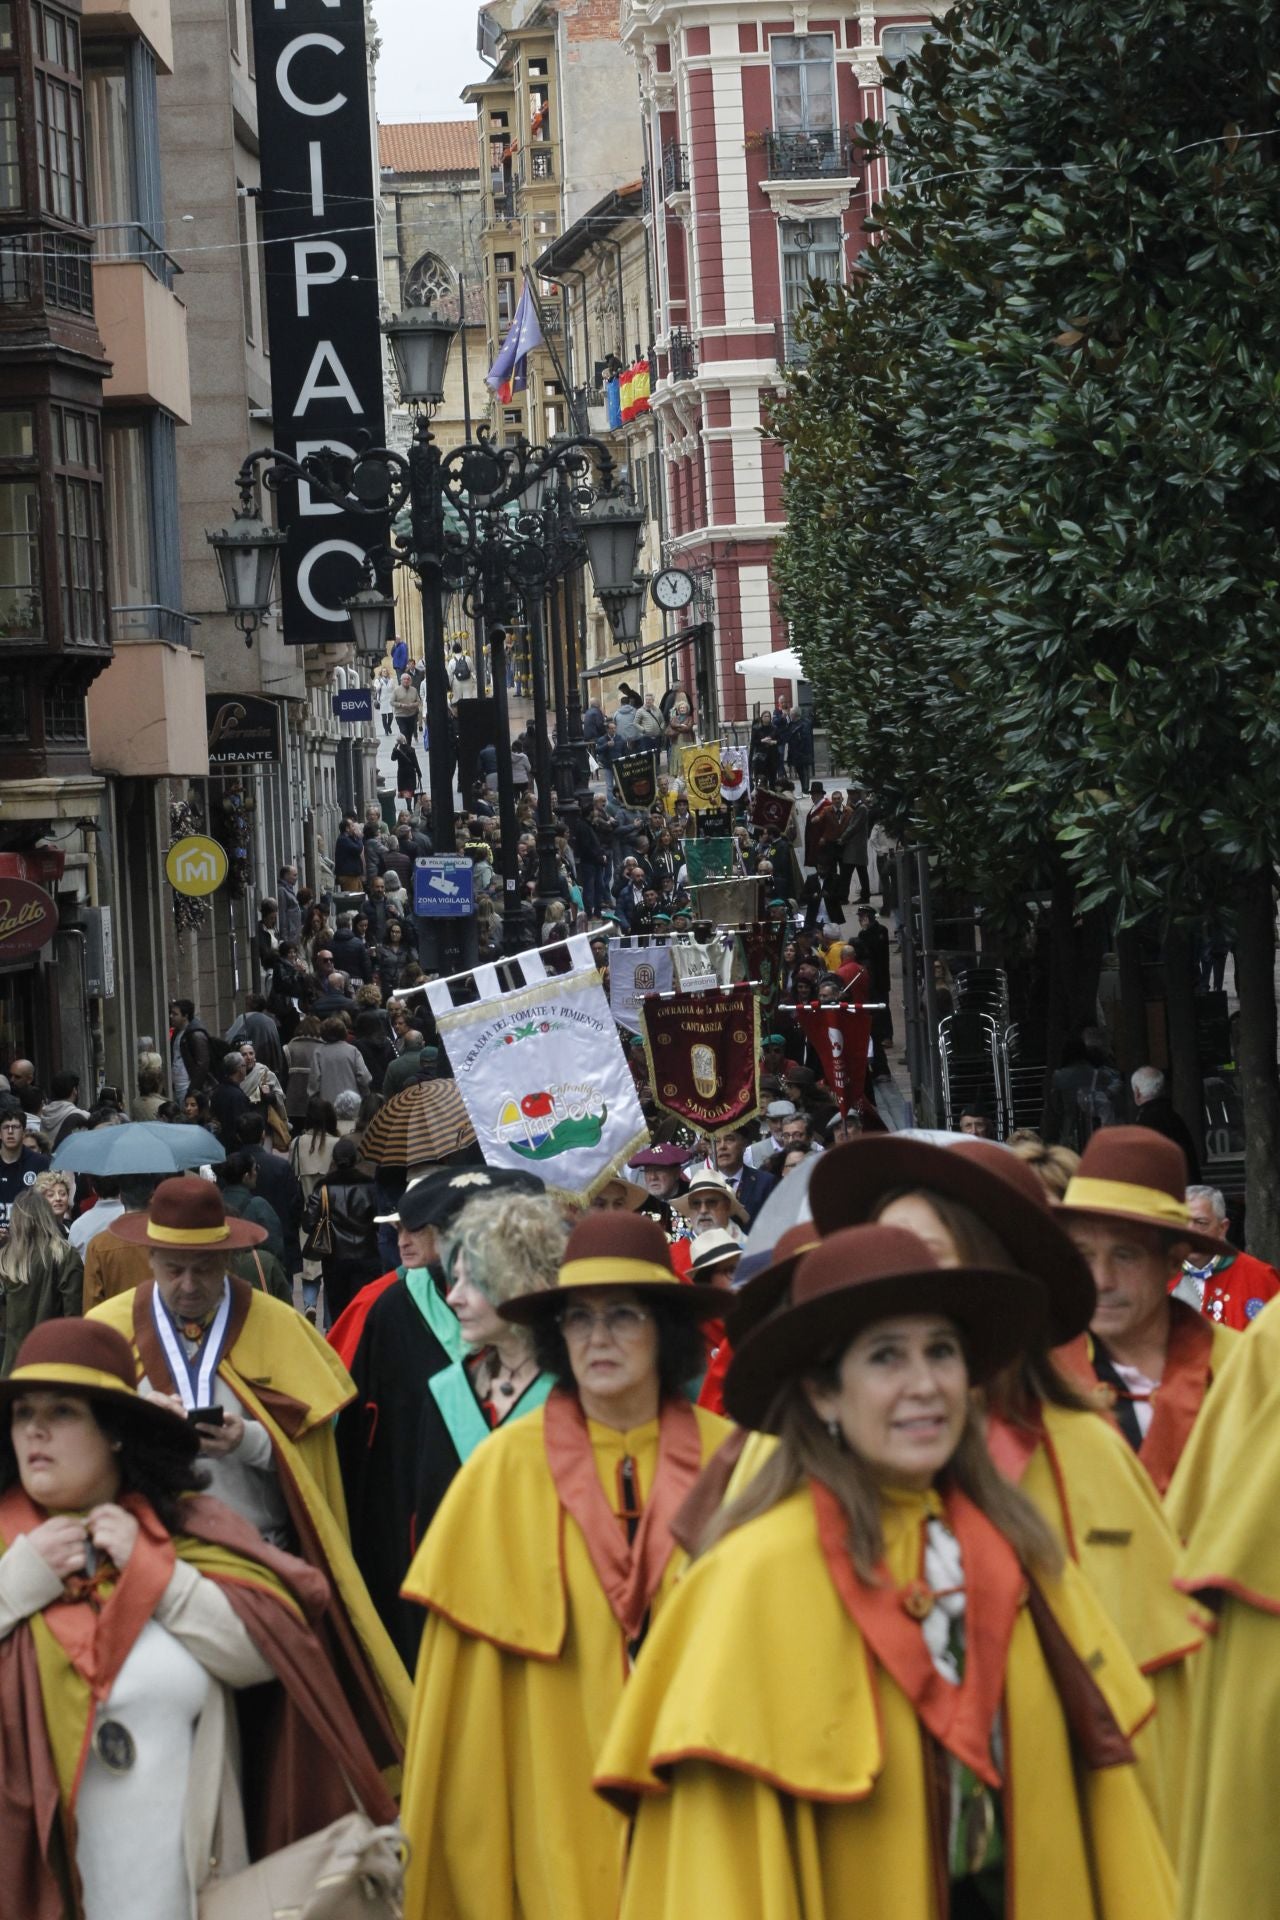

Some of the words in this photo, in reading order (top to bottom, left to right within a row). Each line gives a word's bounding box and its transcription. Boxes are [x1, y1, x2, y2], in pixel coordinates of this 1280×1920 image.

[274, 0, 376, 622] CIPADO
[341, 701, 368, 710] BBVA
[492, 1020, 509, 1033] DEL
[510, 1006, 548, 1024] TOMATE
[550, 1005, 556, 1015] Y
[560, 1007, 604, 1032] PIMIENTO
[681, 1021, 723, 1033] CANTABRIA
